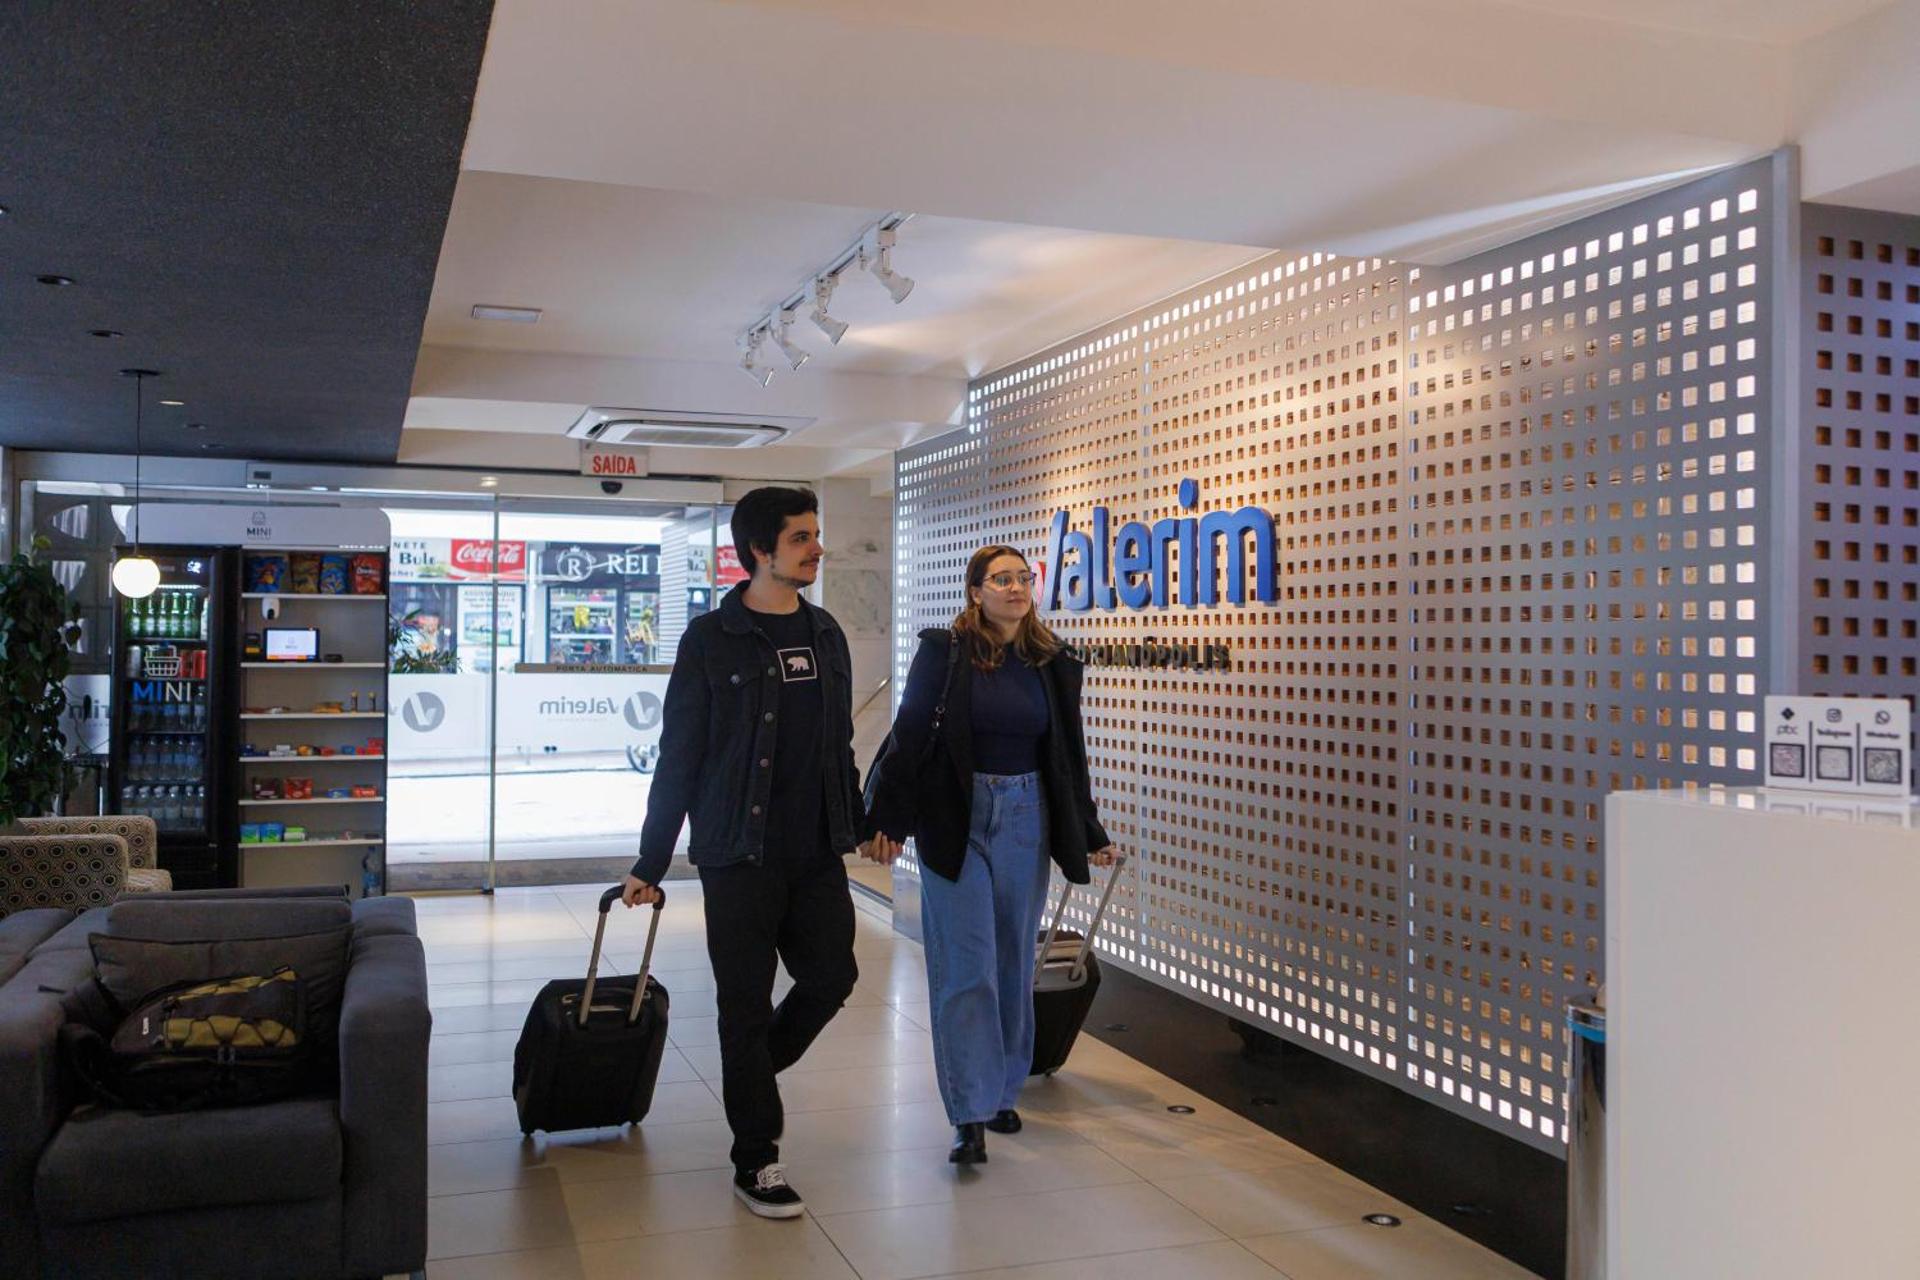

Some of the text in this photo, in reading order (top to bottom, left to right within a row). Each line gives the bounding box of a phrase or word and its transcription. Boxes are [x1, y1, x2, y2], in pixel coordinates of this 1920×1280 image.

[593, 455, 636, 474] SAÍDA
[246, 527, 272, 537] MINI
[1031, 477, 1278, 611] Valerim
[606, 554, 649, 575] REI
[132, 681, 191, 702] MINI
